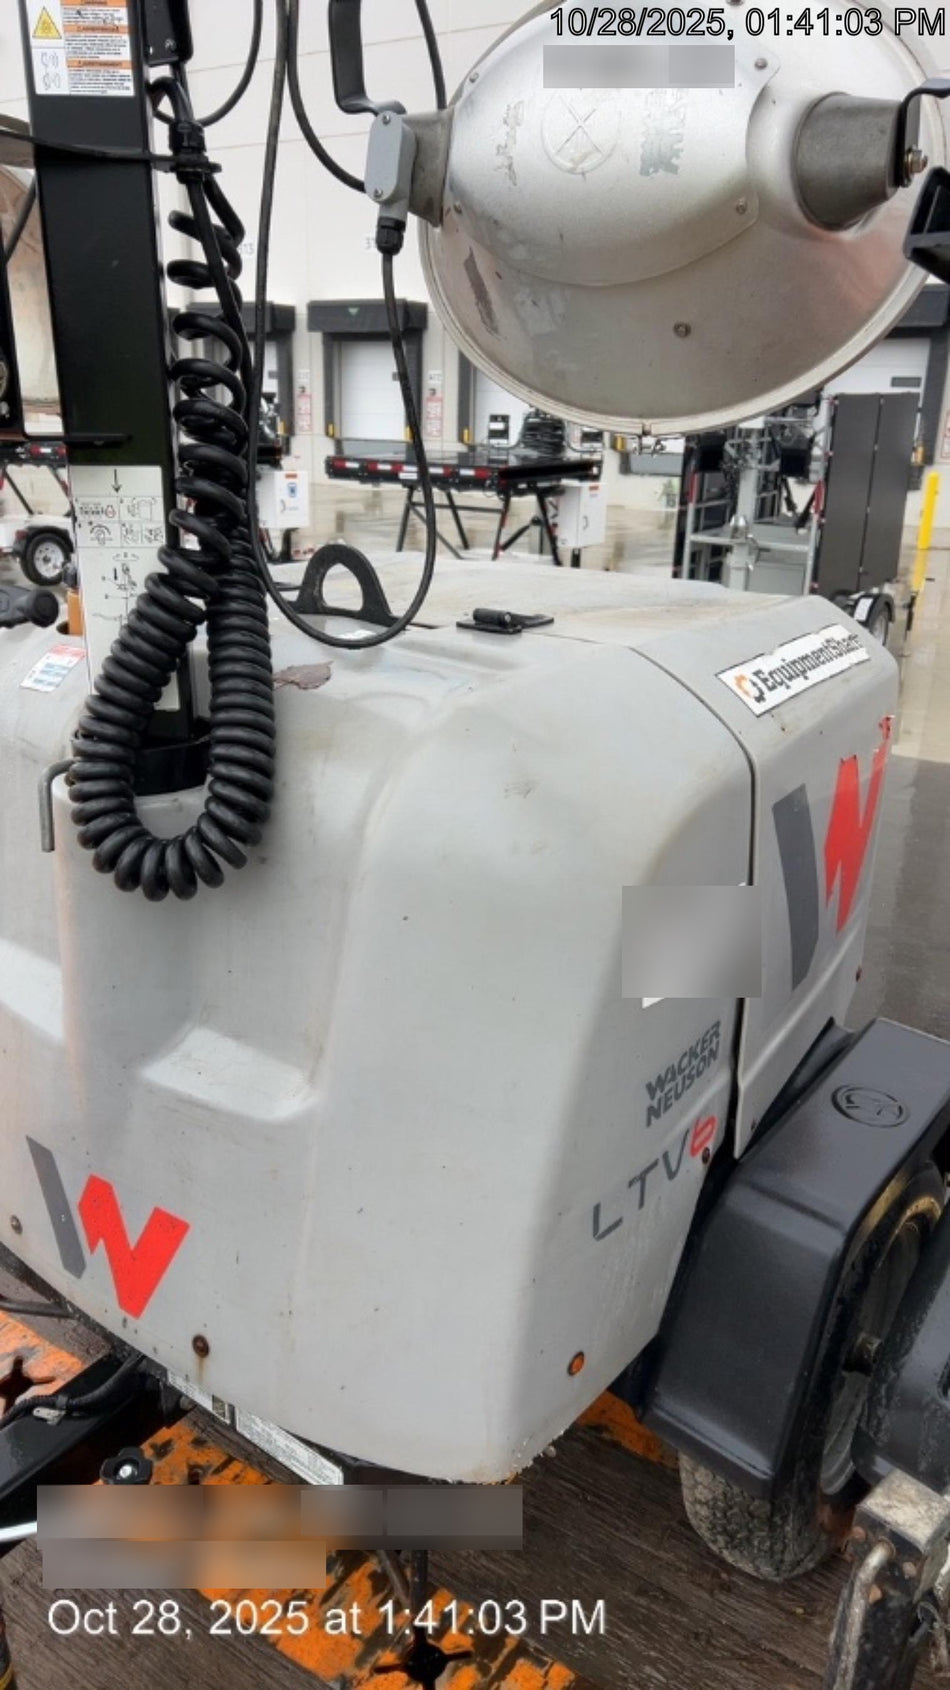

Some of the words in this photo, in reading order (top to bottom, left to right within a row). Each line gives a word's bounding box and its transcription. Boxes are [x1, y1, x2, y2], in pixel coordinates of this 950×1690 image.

[645, 1020, 721, 1100] WACKER
[645, 1040, 720, 1128] NEUSON
[593, 1114, 718, 1241] LTV6
